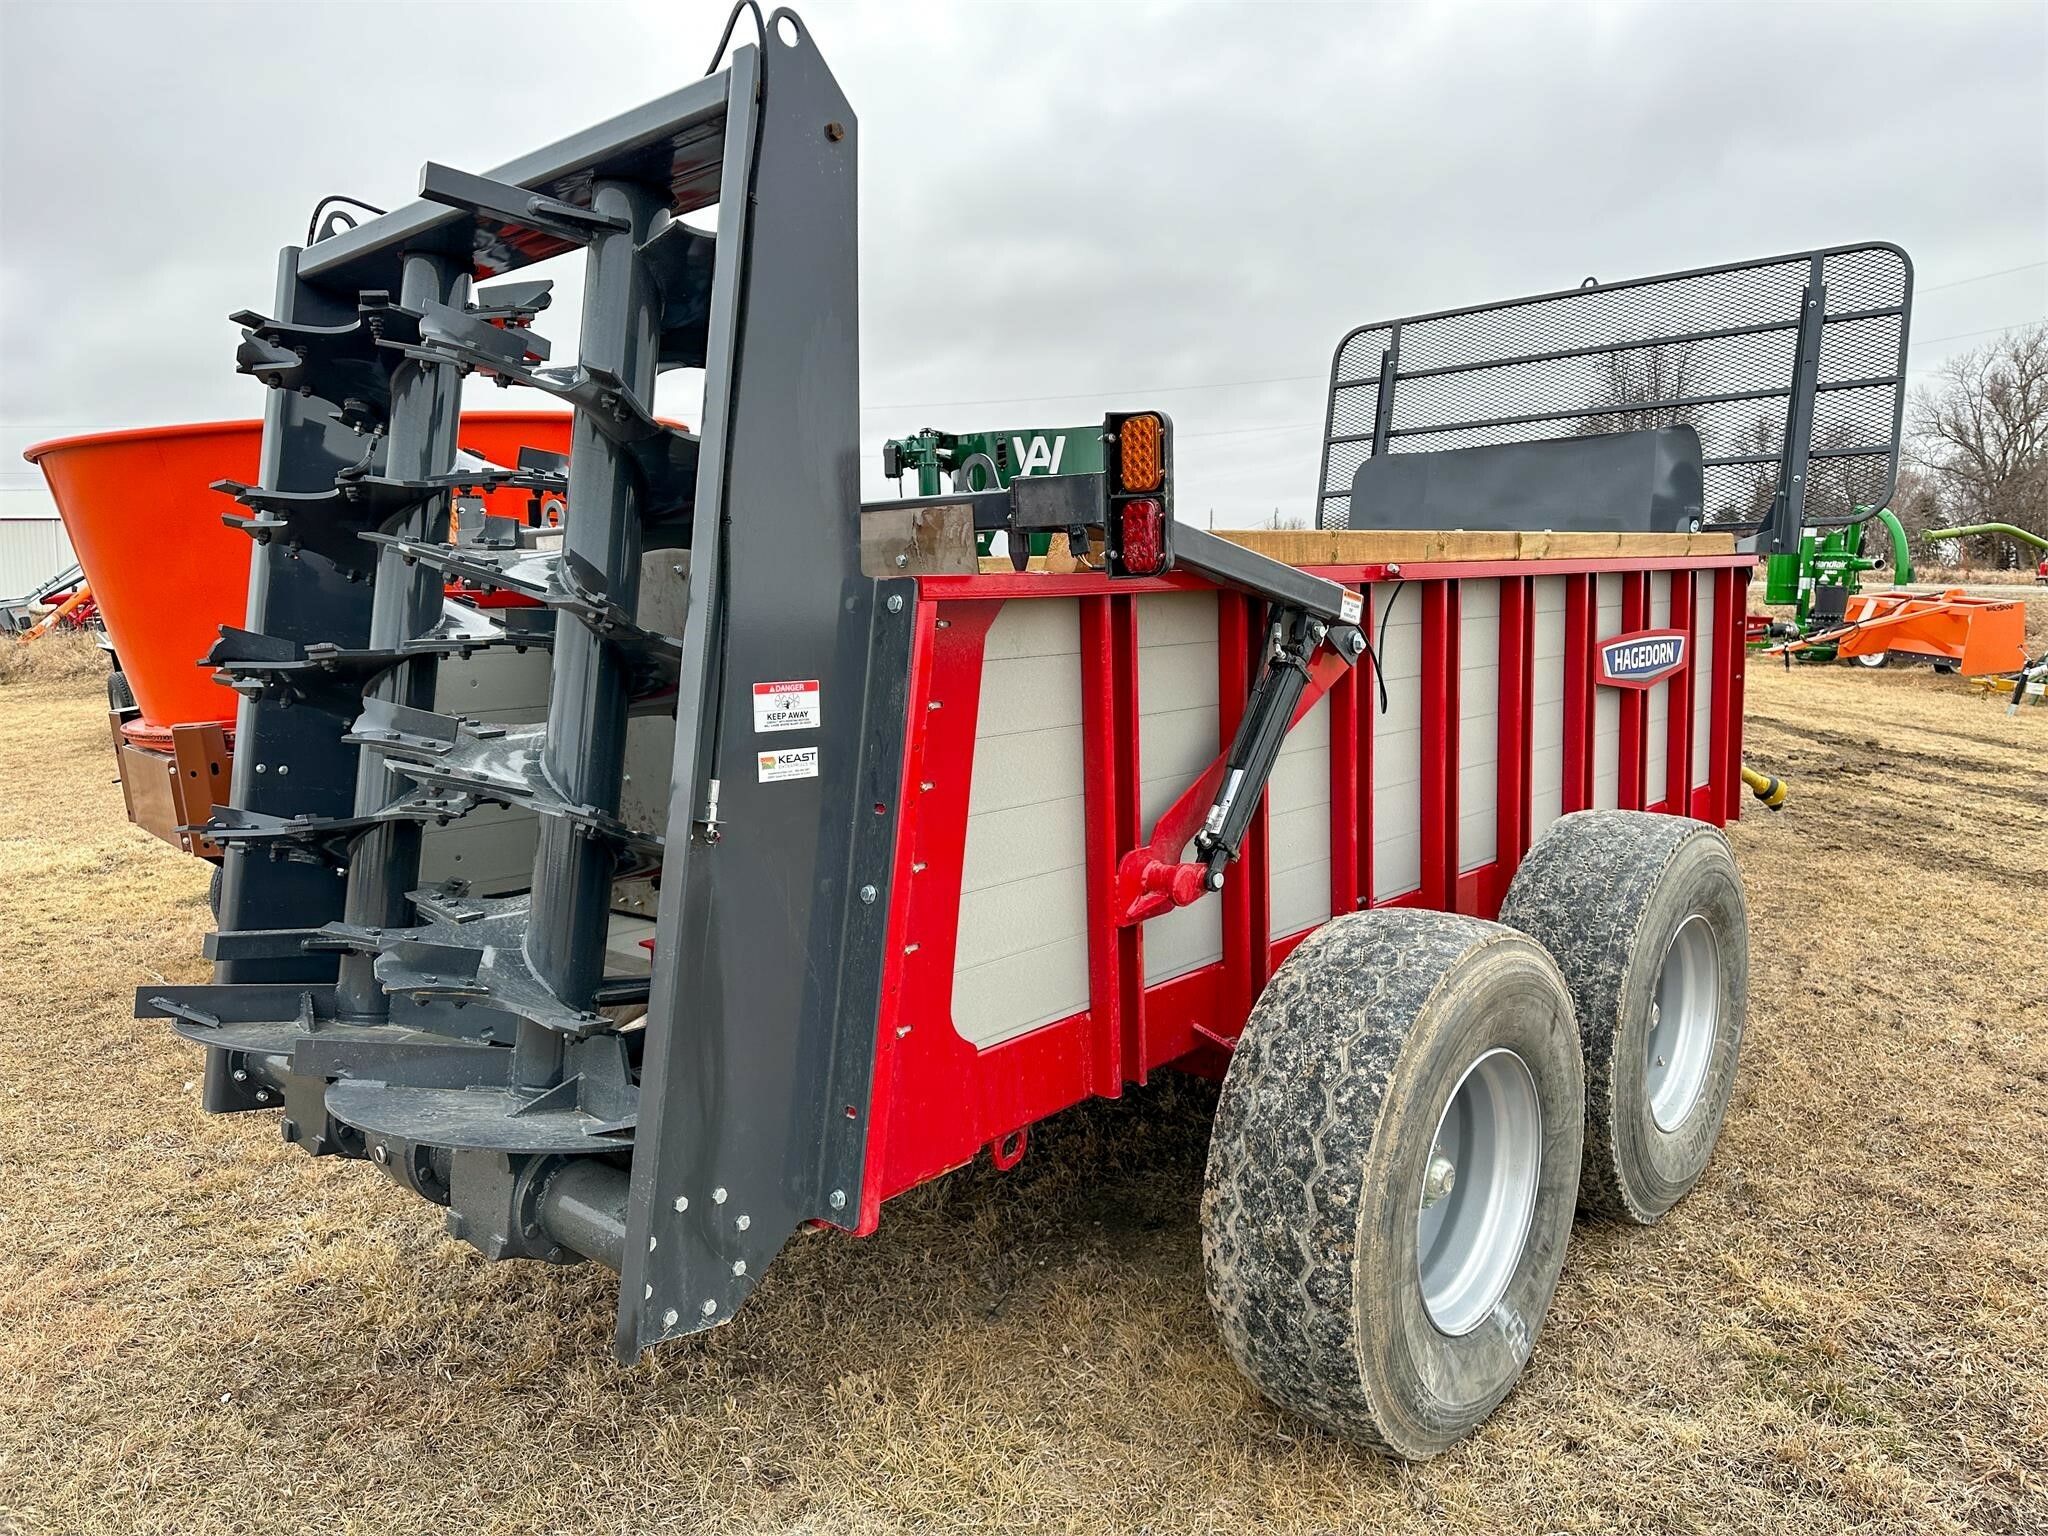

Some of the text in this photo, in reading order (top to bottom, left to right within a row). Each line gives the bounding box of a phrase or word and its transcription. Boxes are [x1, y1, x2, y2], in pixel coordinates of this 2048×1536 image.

[1614, 642, 1674, 672] HAGEDORN
[775, 683, 805, 693] DANGER
[767, 711, 808, 720] KEEP AWAY
[778, 752, 816, 764] KEAST
